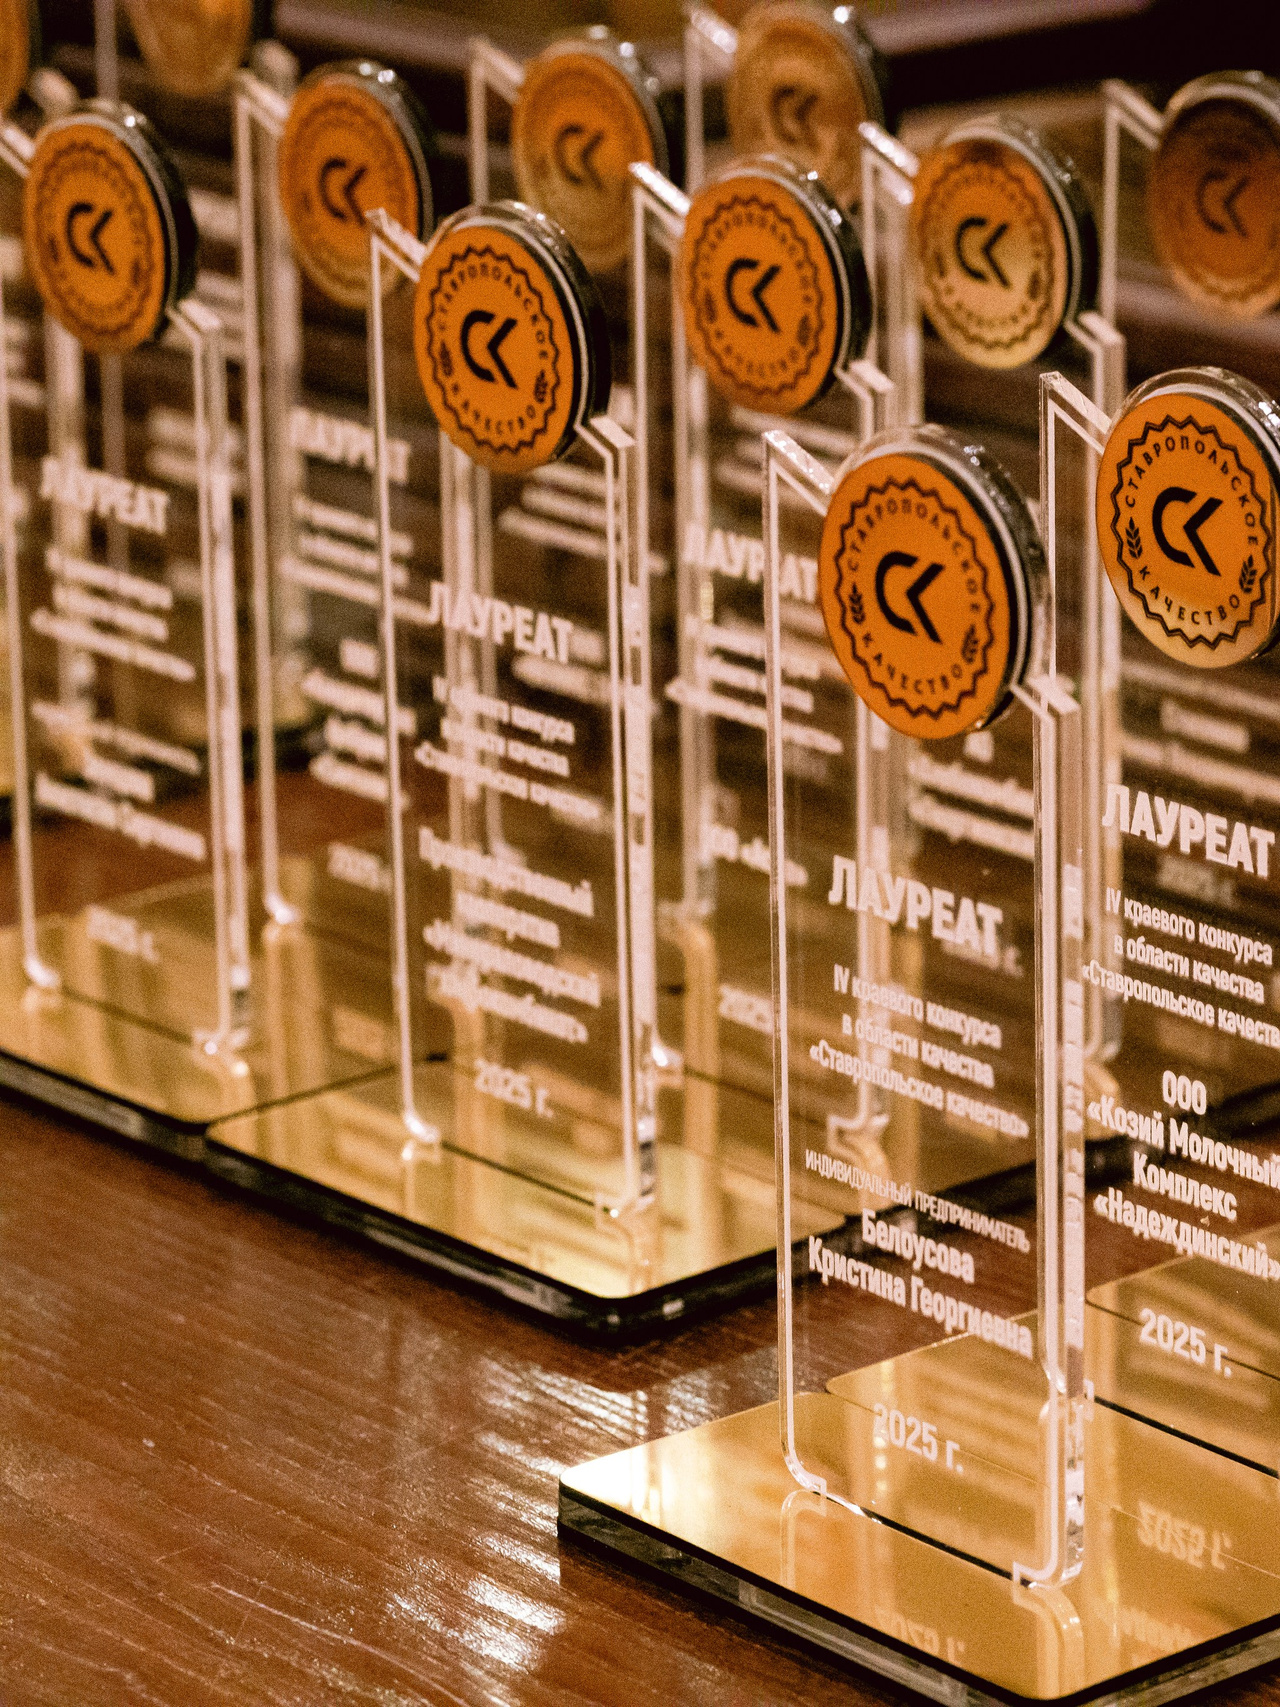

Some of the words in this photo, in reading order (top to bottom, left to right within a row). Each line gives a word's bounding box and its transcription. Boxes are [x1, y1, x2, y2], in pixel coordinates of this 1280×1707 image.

[1125, 435, 1259, 545] СТАВРОПОЛЬСКОЕ
[1139, 566, 1241, 626] КАЧЕСТВО
[1102, 782, 1276, 878] ЛАУРЕАТ
[828, 854, 1003, 957] ЛАУРЕАТ
[1105, 887, 1122, 916] IV
[1123, 897, 1196, 943] краевого
[1199, 922, 1273, 966] конкурса
[834, 963, 850, 994] IV
[926, 1001, 1002, 1050] конкурса
[1083, 959, 1215, 1028] «Ставропольское
[1113, 934, 1124, 957] в
[1126, 935, 1190, 978] области
[1192, 960, 1265, 1004] качества
[842, 1013, 852, 1036] в
[921, 1041, 995, 1089] качества
[1087, 1096, 1164, 1150] «Козий
[1162, 1069, 1208, 1116] ООО
[805, 1149, 912, 1207] ИНДИВИДУАЛЬНЫЙ
[914, 1190, 1031, 1254] ПРЕДПРИНИМАТЕЛЬ
[1132, 1150, 1238, 1222] Комплекс
[862, 1207, 975, 1284] Белоусова
[808, 1235, 907, 1308] Кристина
[910, 1274, 1033, 1361] Георгиевна
[1138, 1307, 1207, 1367] 2025
[1213, 1343, 1233, 1378] г.
[872, 1402, 939, 1463] 2025
[945, 1440, 964, 1474] г.
